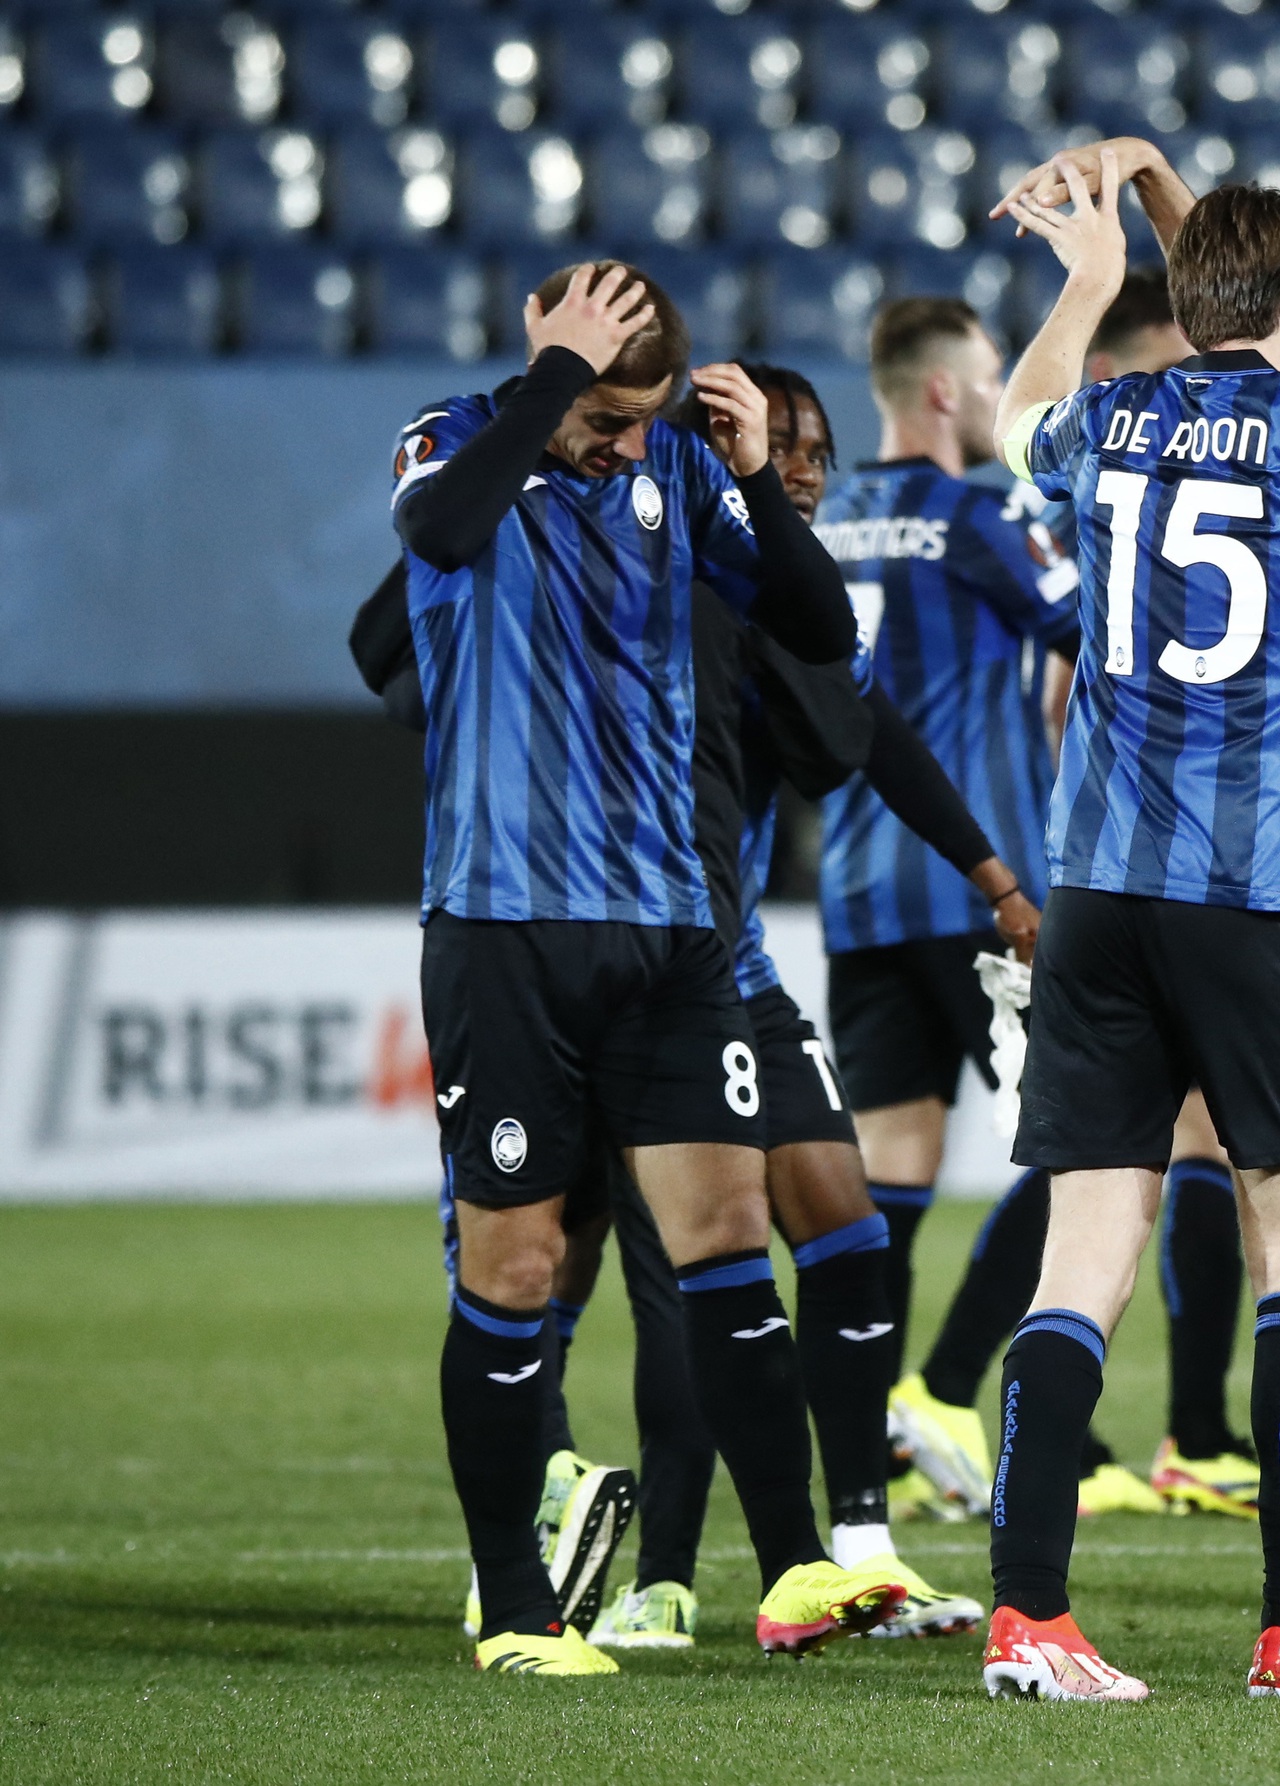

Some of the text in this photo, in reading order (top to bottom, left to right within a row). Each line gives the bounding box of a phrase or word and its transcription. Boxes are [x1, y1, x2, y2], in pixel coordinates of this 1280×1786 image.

[1101, 409, 1160, 454] DE
[1161, 417, 1269, 466] ROON
[1095, 470, 1268, 685] 15
[101, 1002, 365, 1112] RISE
[722, 1040, 760, 1118] 8
[993, 1380, 1021, 1528] ATALANTA BERGAMO
